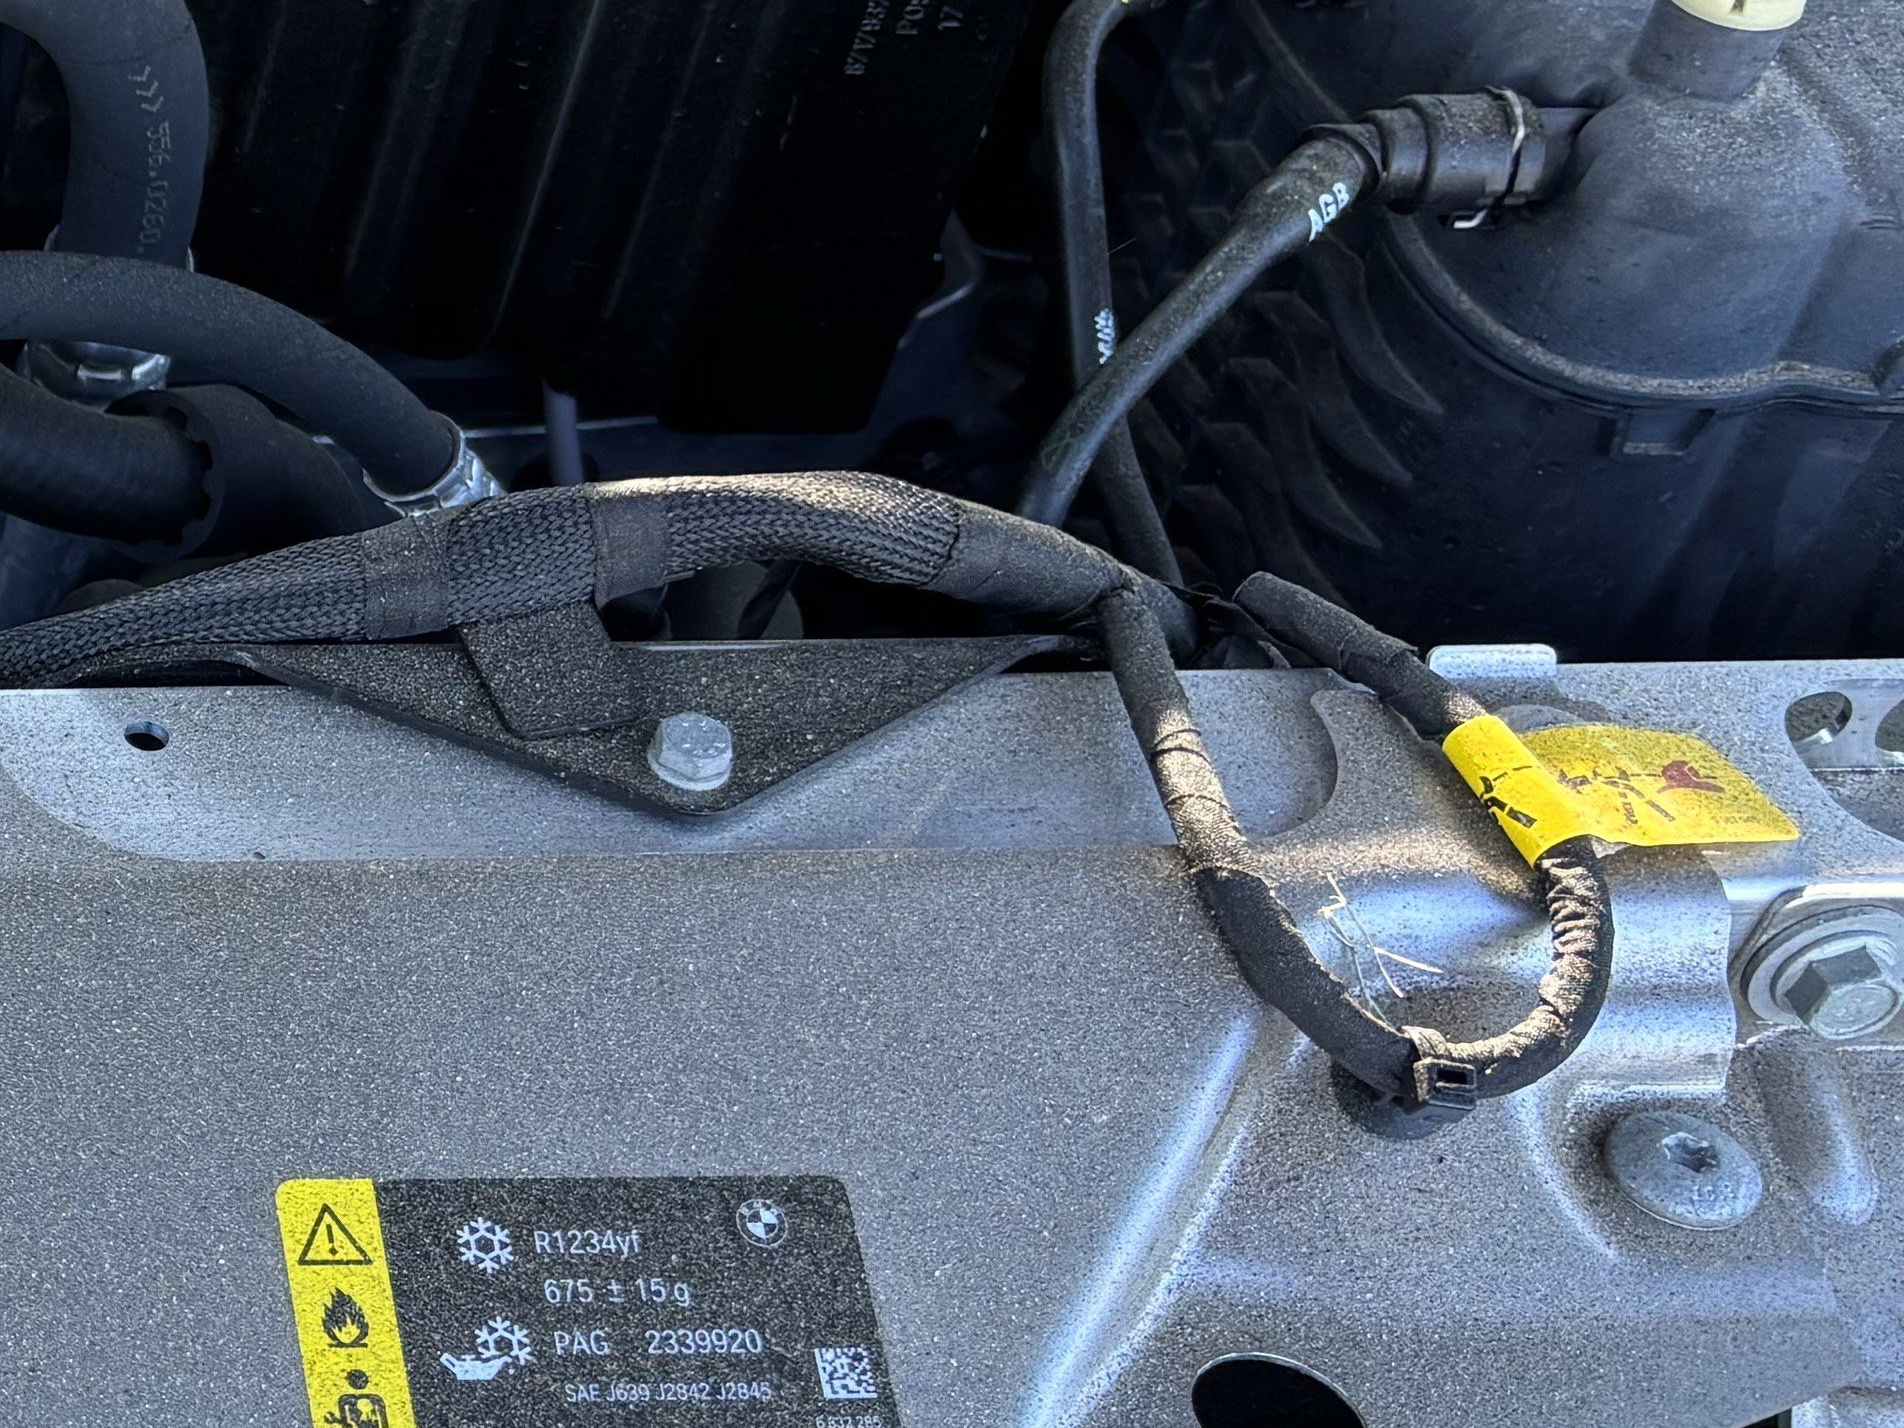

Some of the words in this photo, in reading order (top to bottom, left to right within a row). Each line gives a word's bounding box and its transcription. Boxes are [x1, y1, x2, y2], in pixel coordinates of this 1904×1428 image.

[1305, 179, 1350, 245] AGB
[533, 1228, 643, 1259] R1234yf
[543, 1278, 595, 1305] 675
[635, 1277, 667, 1304] 15
[674, 1282, 692, 1309] g
[553, 1330, 611, 1356] PAG
[645, 1328, 764, 1355] 2339920
[564, 1383, 600, 1403] SAE
[657, 1382, 713, 1403] J2842
